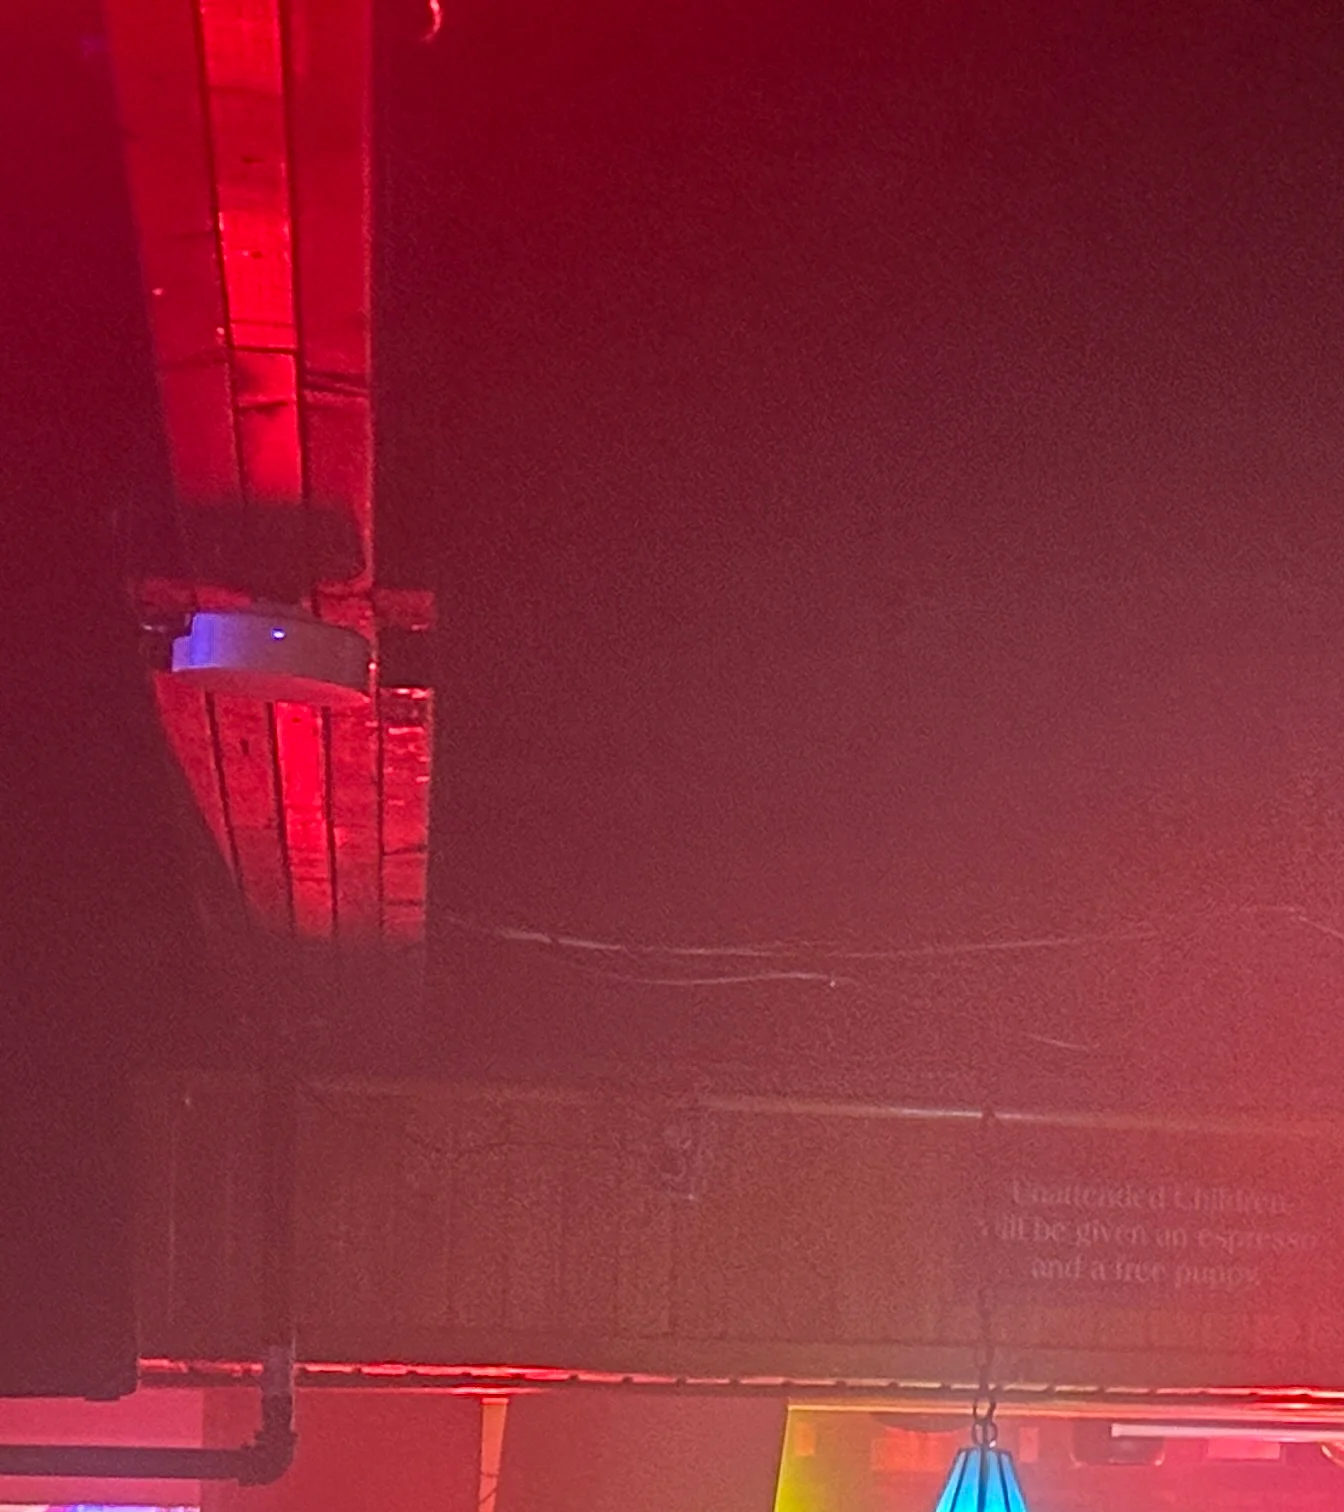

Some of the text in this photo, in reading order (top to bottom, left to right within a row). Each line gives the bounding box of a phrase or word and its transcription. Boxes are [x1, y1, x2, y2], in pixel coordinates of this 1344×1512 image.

[1011, 1179, 1166, 1211] Unattended
[1033, 1215, 1067, 1242] be
[1075, 1217, 1148, 1248] given
[1155, 1226, 1188, 1249] an
[1196, 1228, 1318, 1254] espresso
[1030, 1254, 1082, 1281] and
[1090, 1260, 1107, 1282] a
[1114, 1255, 1167, 1284] free
